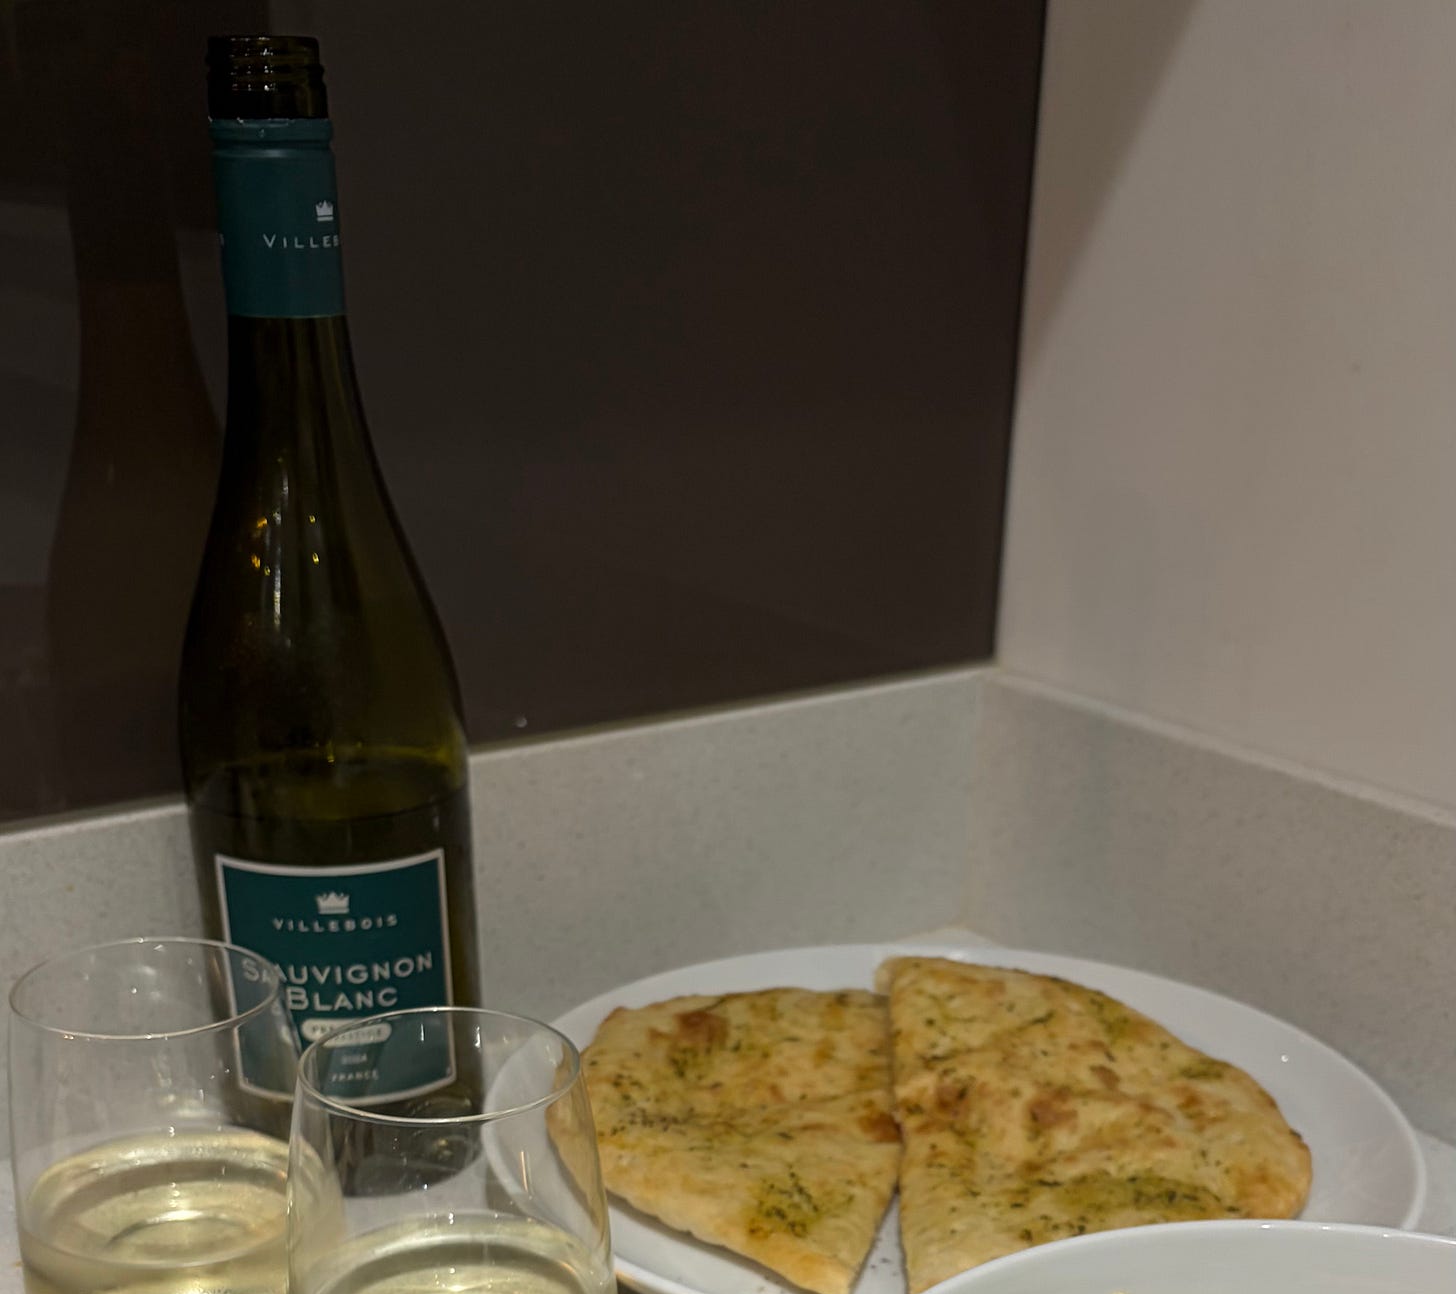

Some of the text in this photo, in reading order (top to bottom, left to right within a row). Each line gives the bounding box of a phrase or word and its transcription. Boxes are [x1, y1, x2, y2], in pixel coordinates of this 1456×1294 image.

[273, 914, 398, 932] VILLEBOIS
[242, 952, 433, 985] SAUVIGNON
[287, 987, 398, 1011] BLANC
